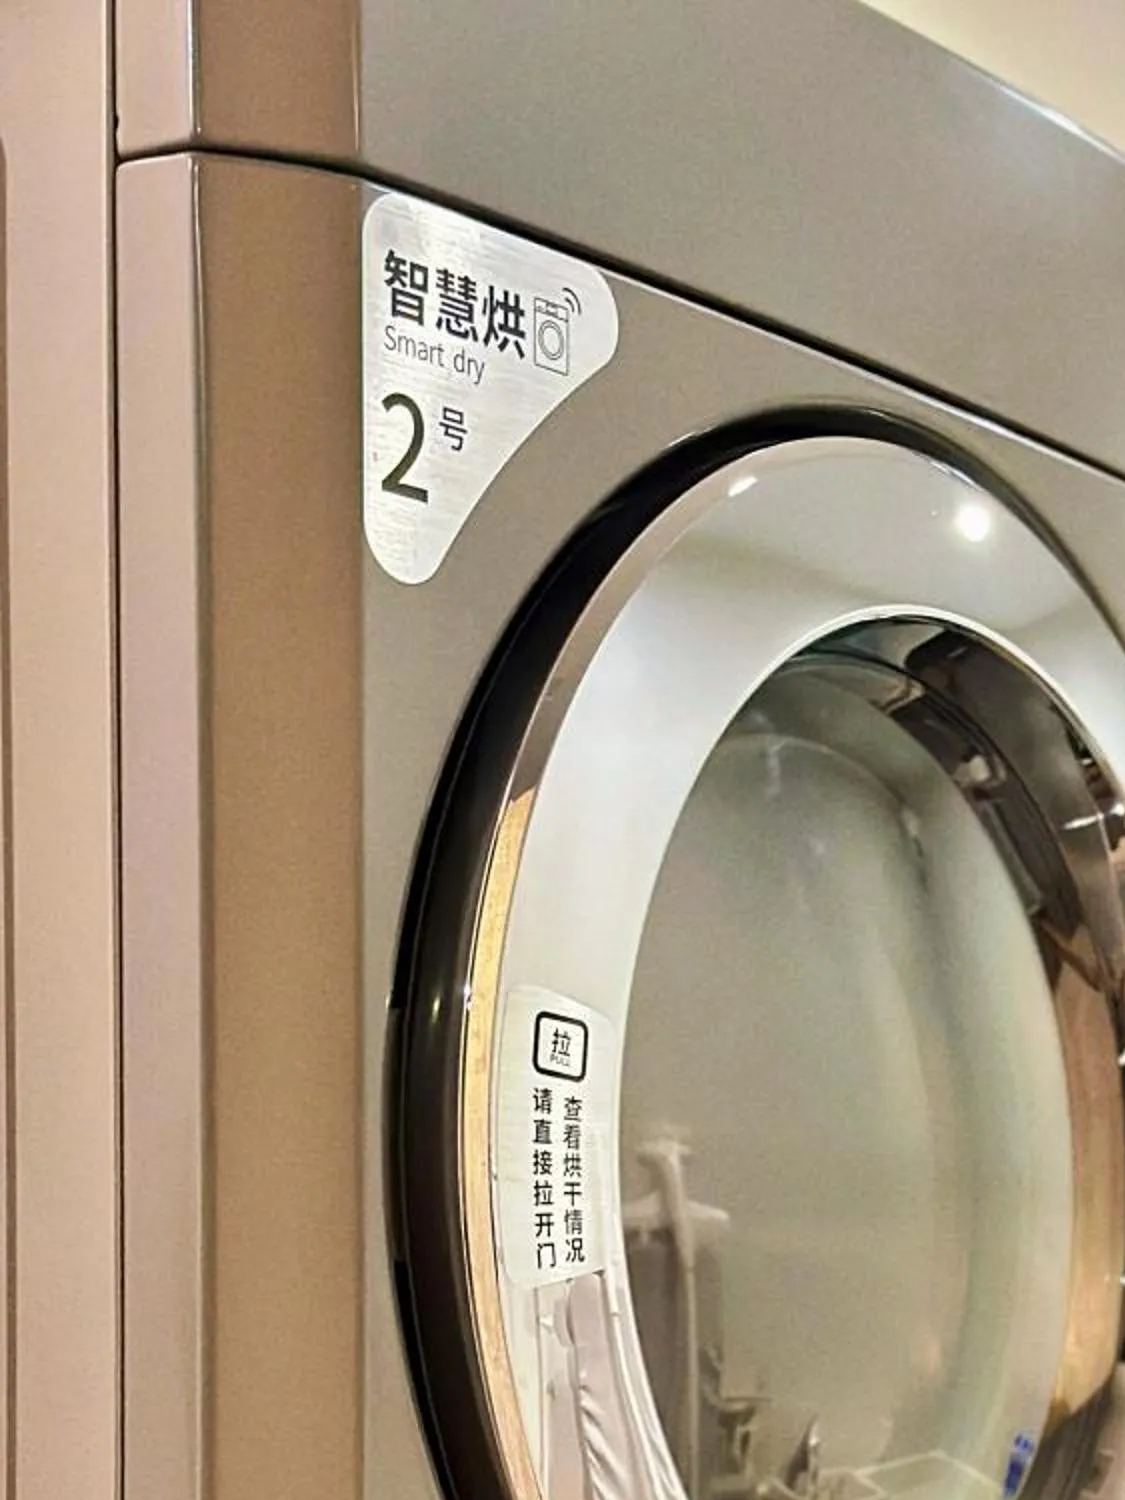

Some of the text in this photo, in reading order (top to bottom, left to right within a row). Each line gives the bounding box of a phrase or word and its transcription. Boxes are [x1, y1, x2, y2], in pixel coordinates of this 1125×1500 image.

[384, 250, 526, 359] 智慧烘
[384, 325, 486, 385] Smart dry
[551, 1027, 571, 1057] 拉
[533, 1087, 556, 1269] 请直接拉开门
[563, 1096, 585, 1263] 查看烘干情况
